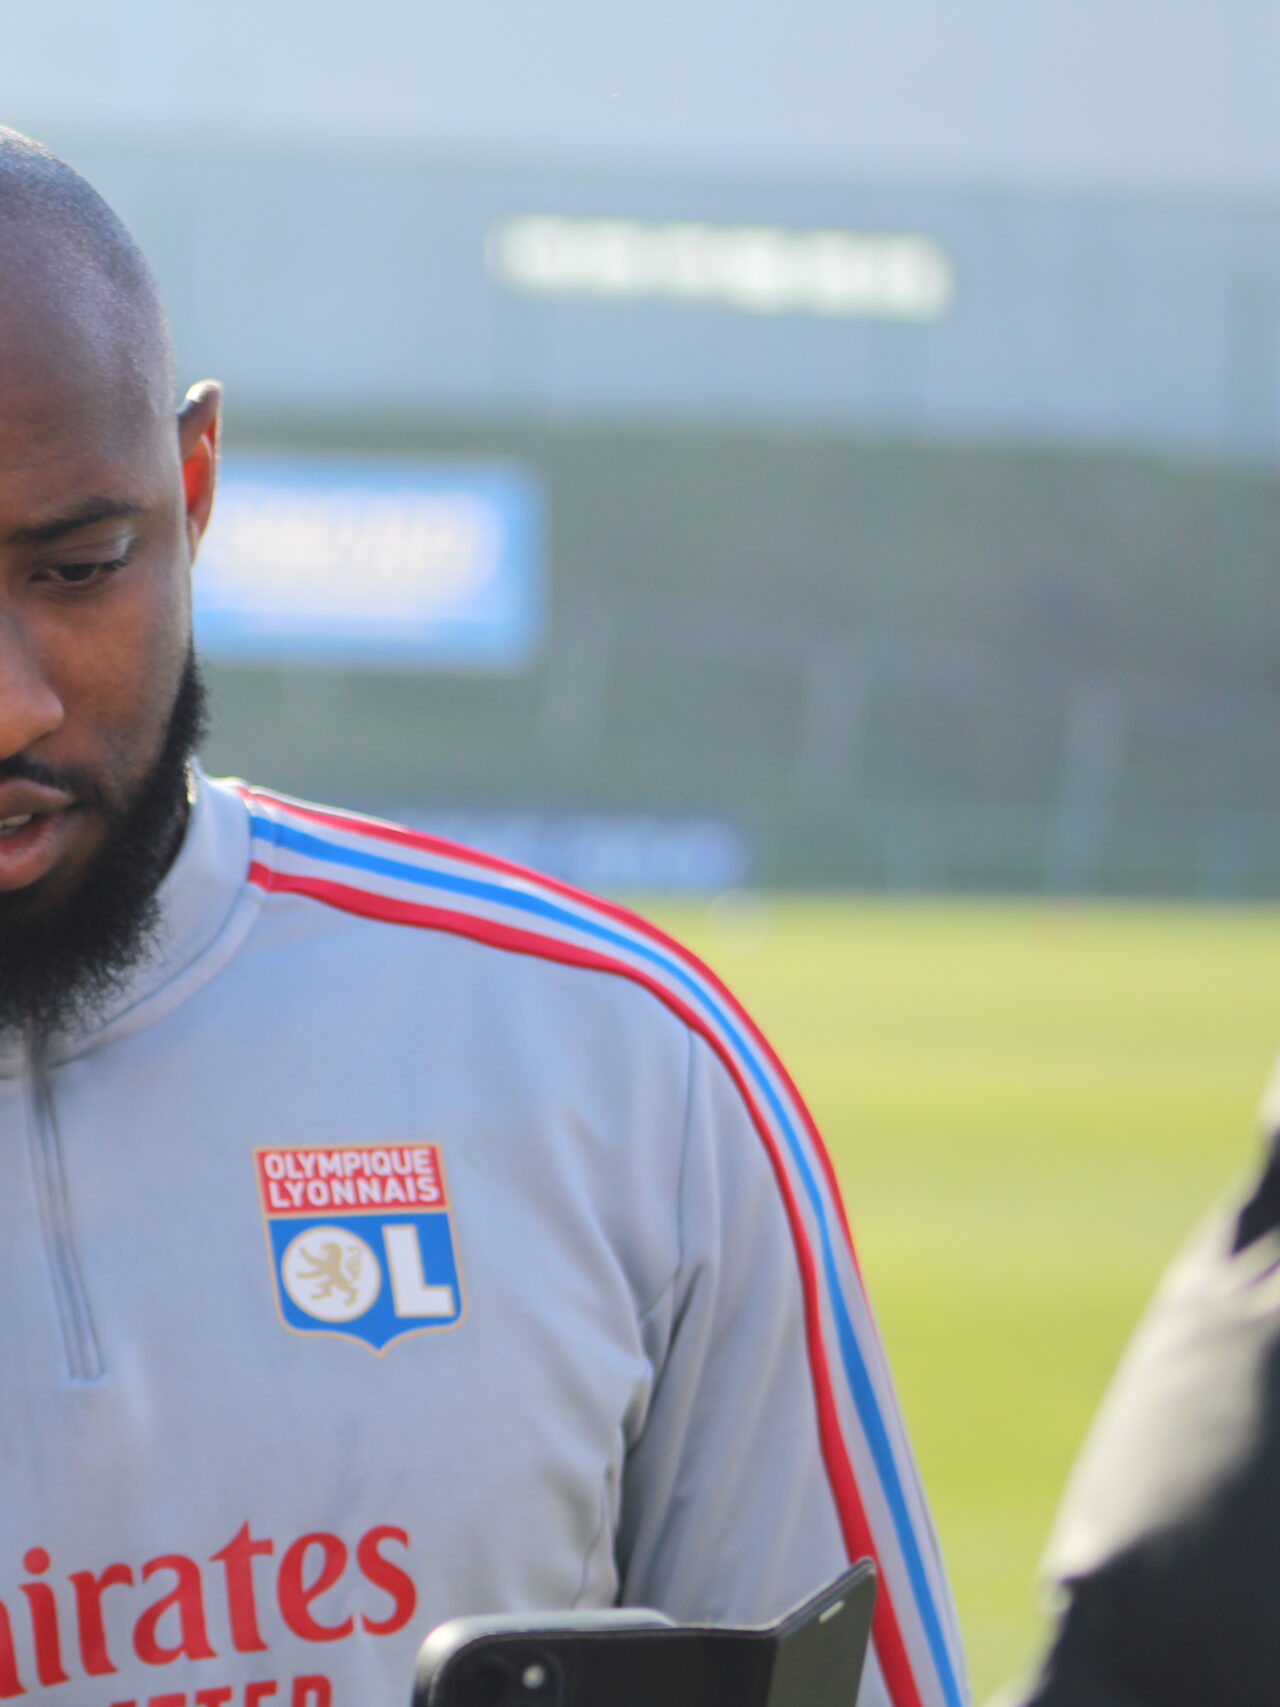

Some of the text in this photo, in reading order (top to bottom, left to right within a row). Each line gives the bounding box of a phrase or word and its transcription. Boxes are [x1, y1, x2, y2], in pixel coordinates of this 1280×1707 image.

[263, 1148, 434, 1180] OLYMPIQUE
[268, 1175, 441, 1208] LYONNAIS
[280, 1224, 456, 1324] OL
